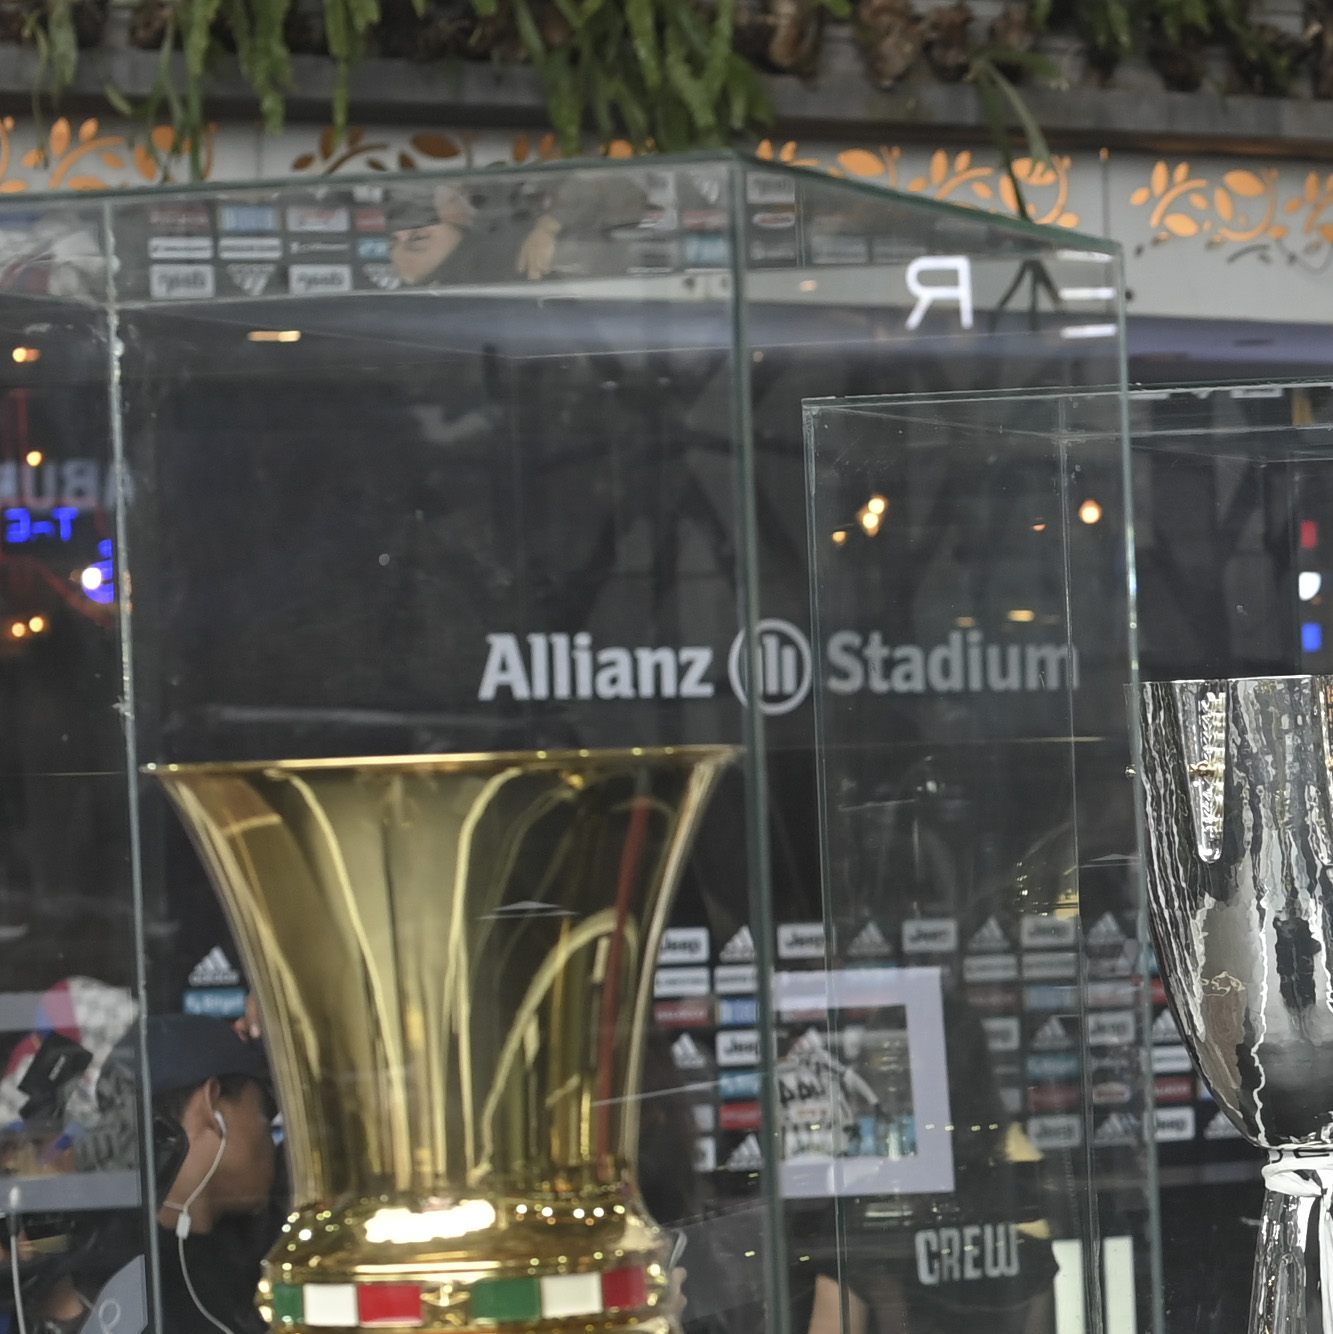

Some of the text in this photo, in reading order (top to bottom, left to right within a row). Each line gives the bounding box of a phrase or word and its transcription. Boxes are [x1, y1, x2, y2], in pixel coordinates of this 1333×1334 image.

[478, 630, 1080, 700] Allianz Stadium
[914, 1222, 1020, 1286] CREW
